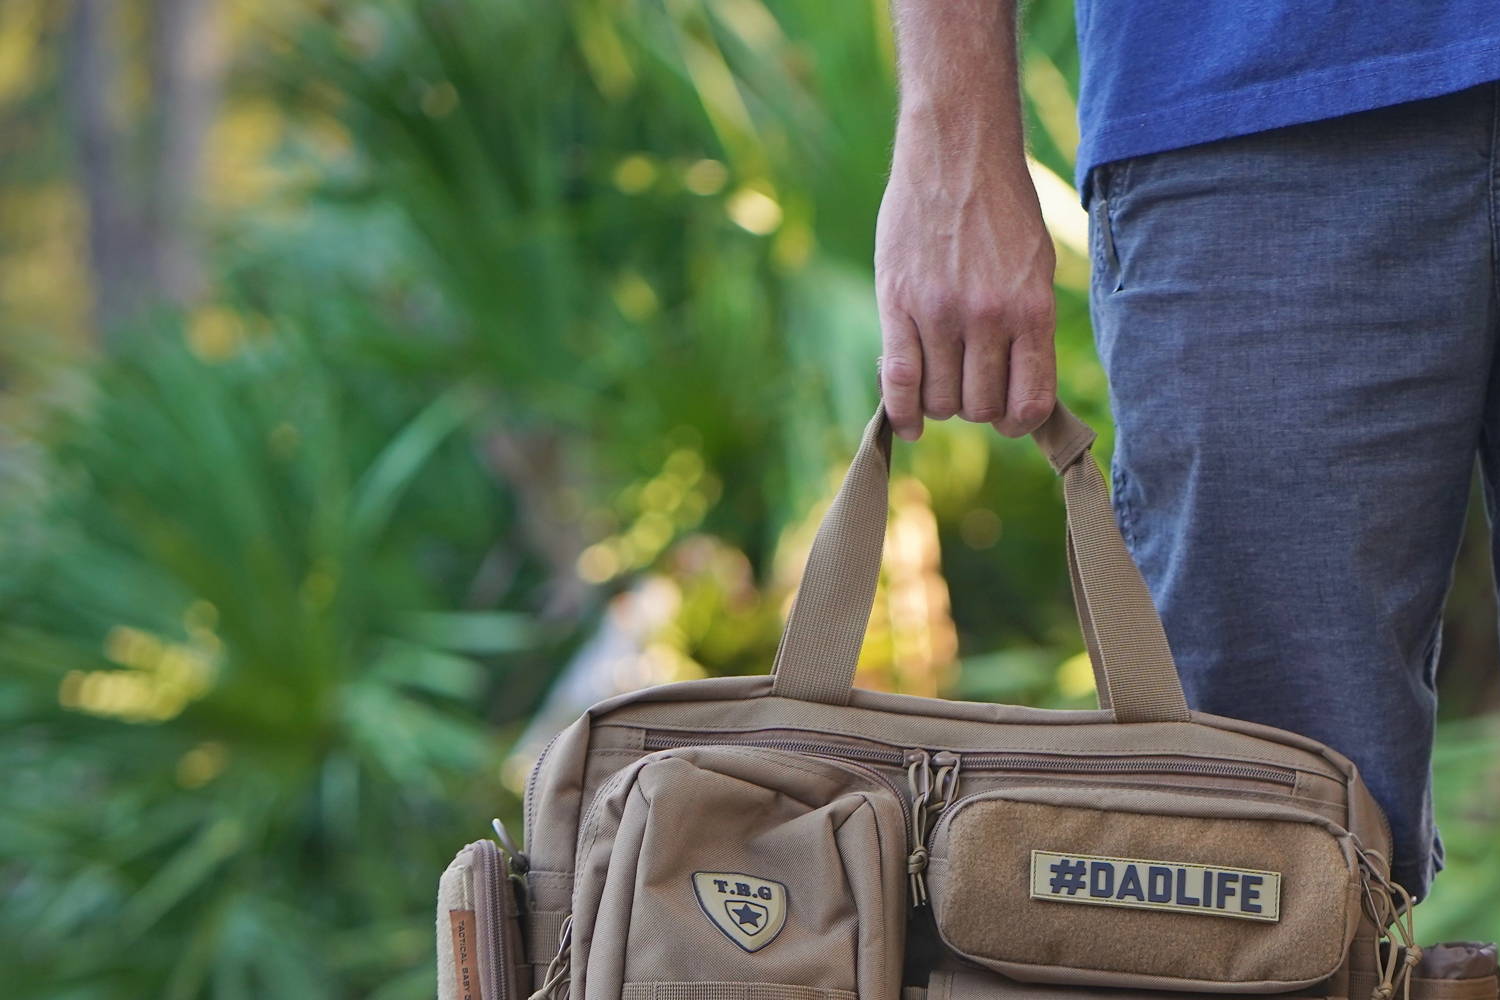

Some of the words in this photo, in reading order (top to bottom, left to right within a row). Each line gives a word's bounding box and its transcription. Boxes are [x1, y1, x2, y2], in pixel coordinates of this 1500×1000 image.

[1049, 859, 1264, 913] #DADLIFE
[458, 920, 467, 965] TACTICAL
[462, 967, 471, 992] BABY
